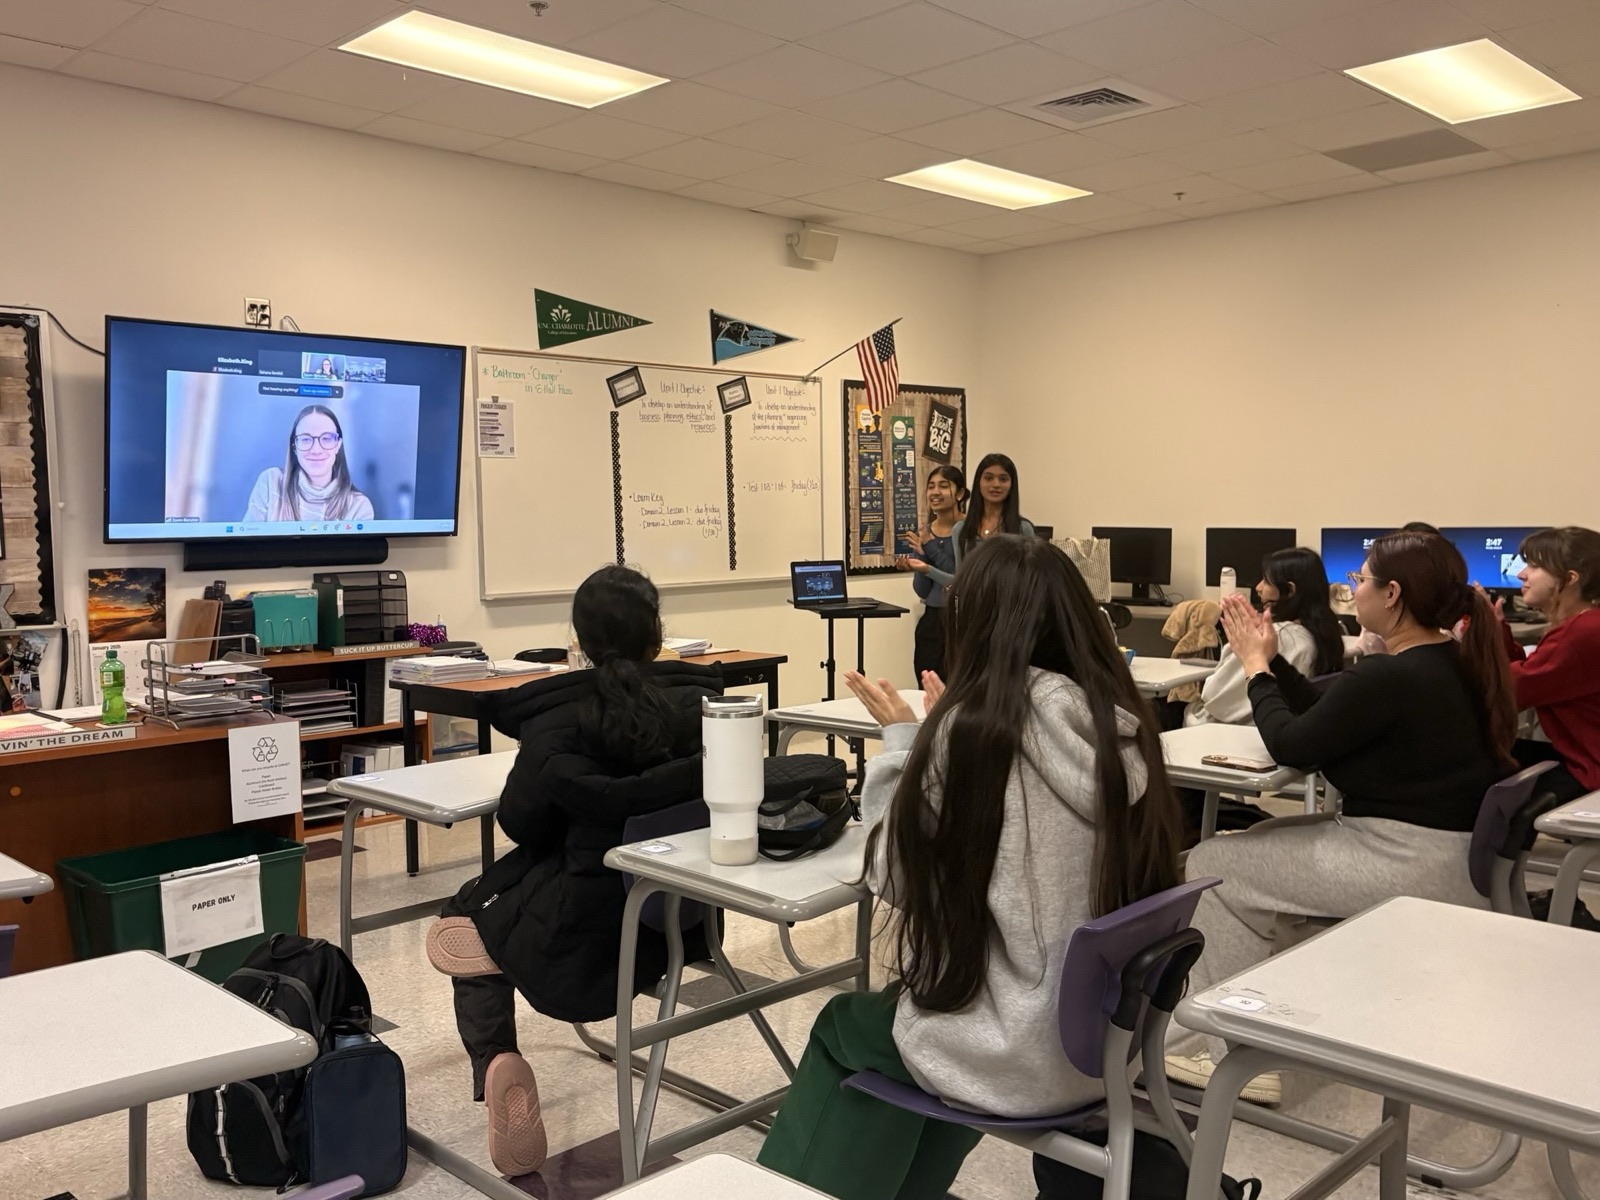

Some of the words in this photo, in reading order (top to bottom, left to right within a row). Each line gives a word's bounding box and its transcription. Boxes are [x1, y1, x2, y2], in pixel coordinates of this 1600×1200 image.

[586, 310, 634, 331] ALUMNI
[491, 365, 526, 379] Bathroom
[557, 384, 574, 395] Pass
[660, 381, 675, 393] Unit
[765, 384, 778, 395] Unit
[746, 481, 759, 492] Test
[667, 505, 685, 514] Lesson
[669, 518, 686, 526] Lesson
[1485, 537, 1503, 547] 2:47
[376, 642, 414, 651] BUTTERCUP
[37, 736, 66, 746] THE
[71, 730, 124, 743] DREAM
[192, 899, 216, 911] PAPER
[218, 894, 236, 904] ONLY
